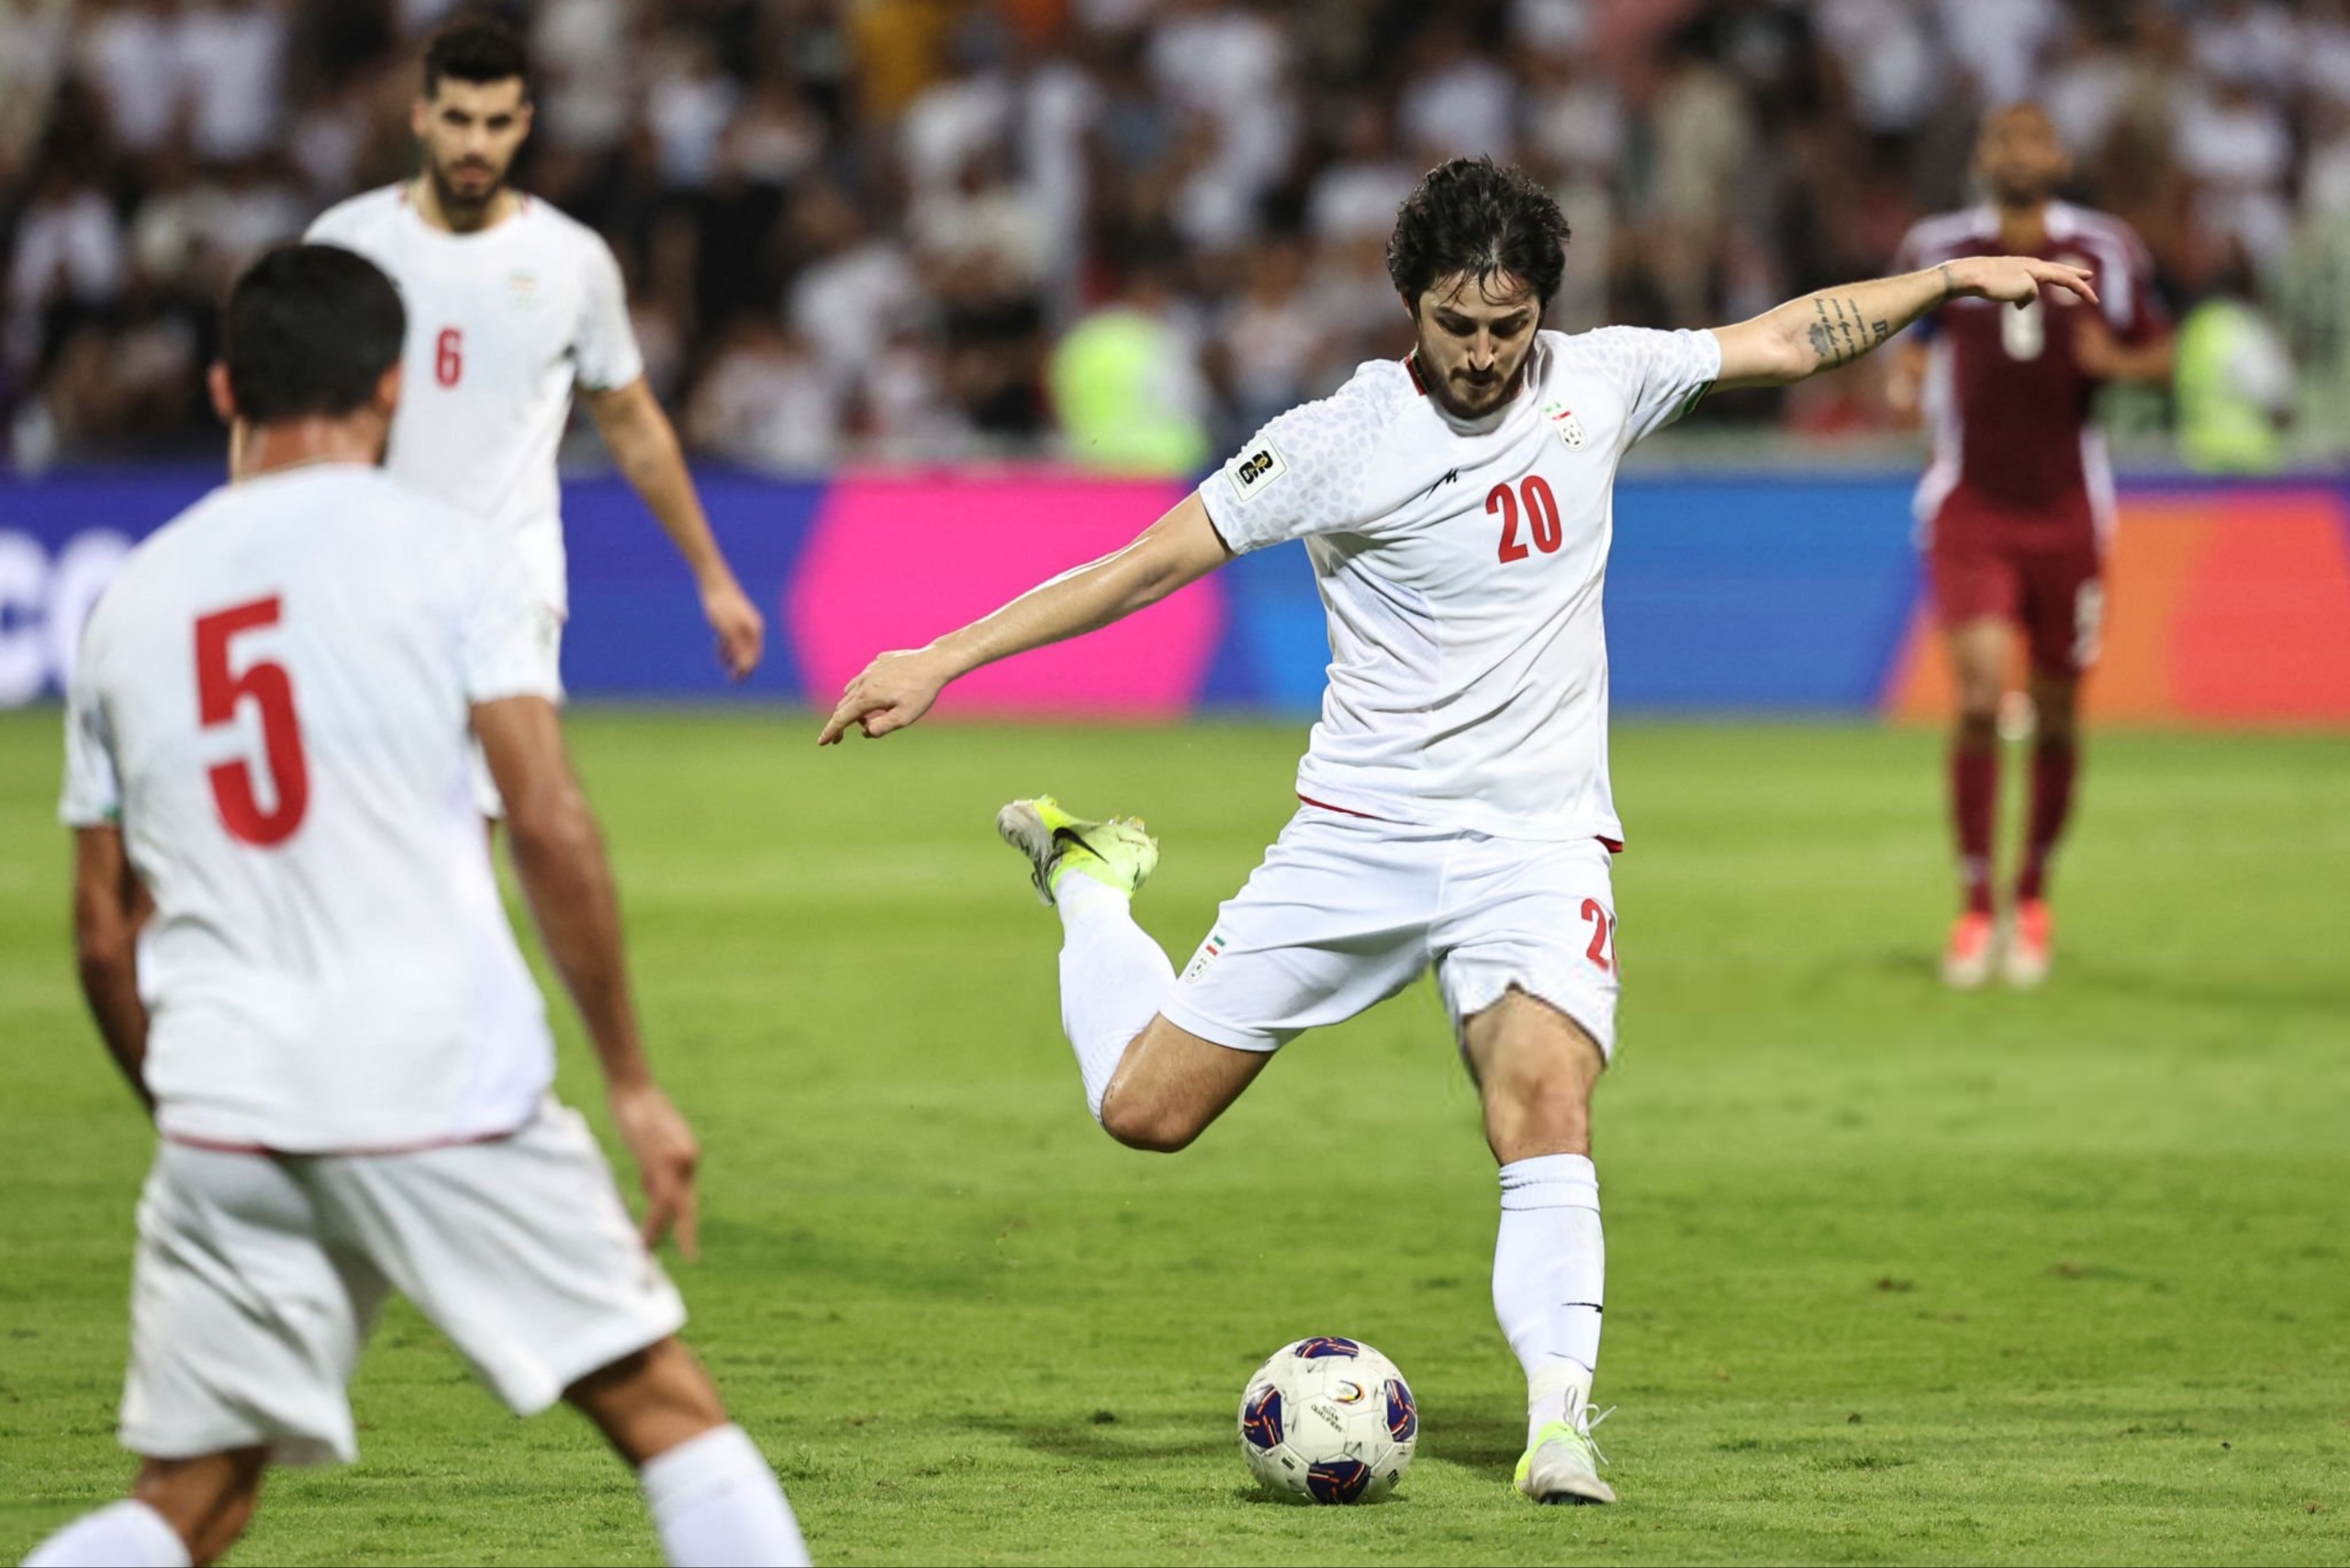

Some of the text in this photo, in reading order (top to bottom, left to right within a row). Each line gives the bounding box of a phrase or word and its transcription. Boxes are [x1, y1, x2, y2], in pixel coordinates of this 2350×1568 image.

[434, 327, 464, 389] 6
[1485, 475, 1563, 565] 20
[195, 594, 309, 848] 5
[1581, 898, 1617, 980] 2
